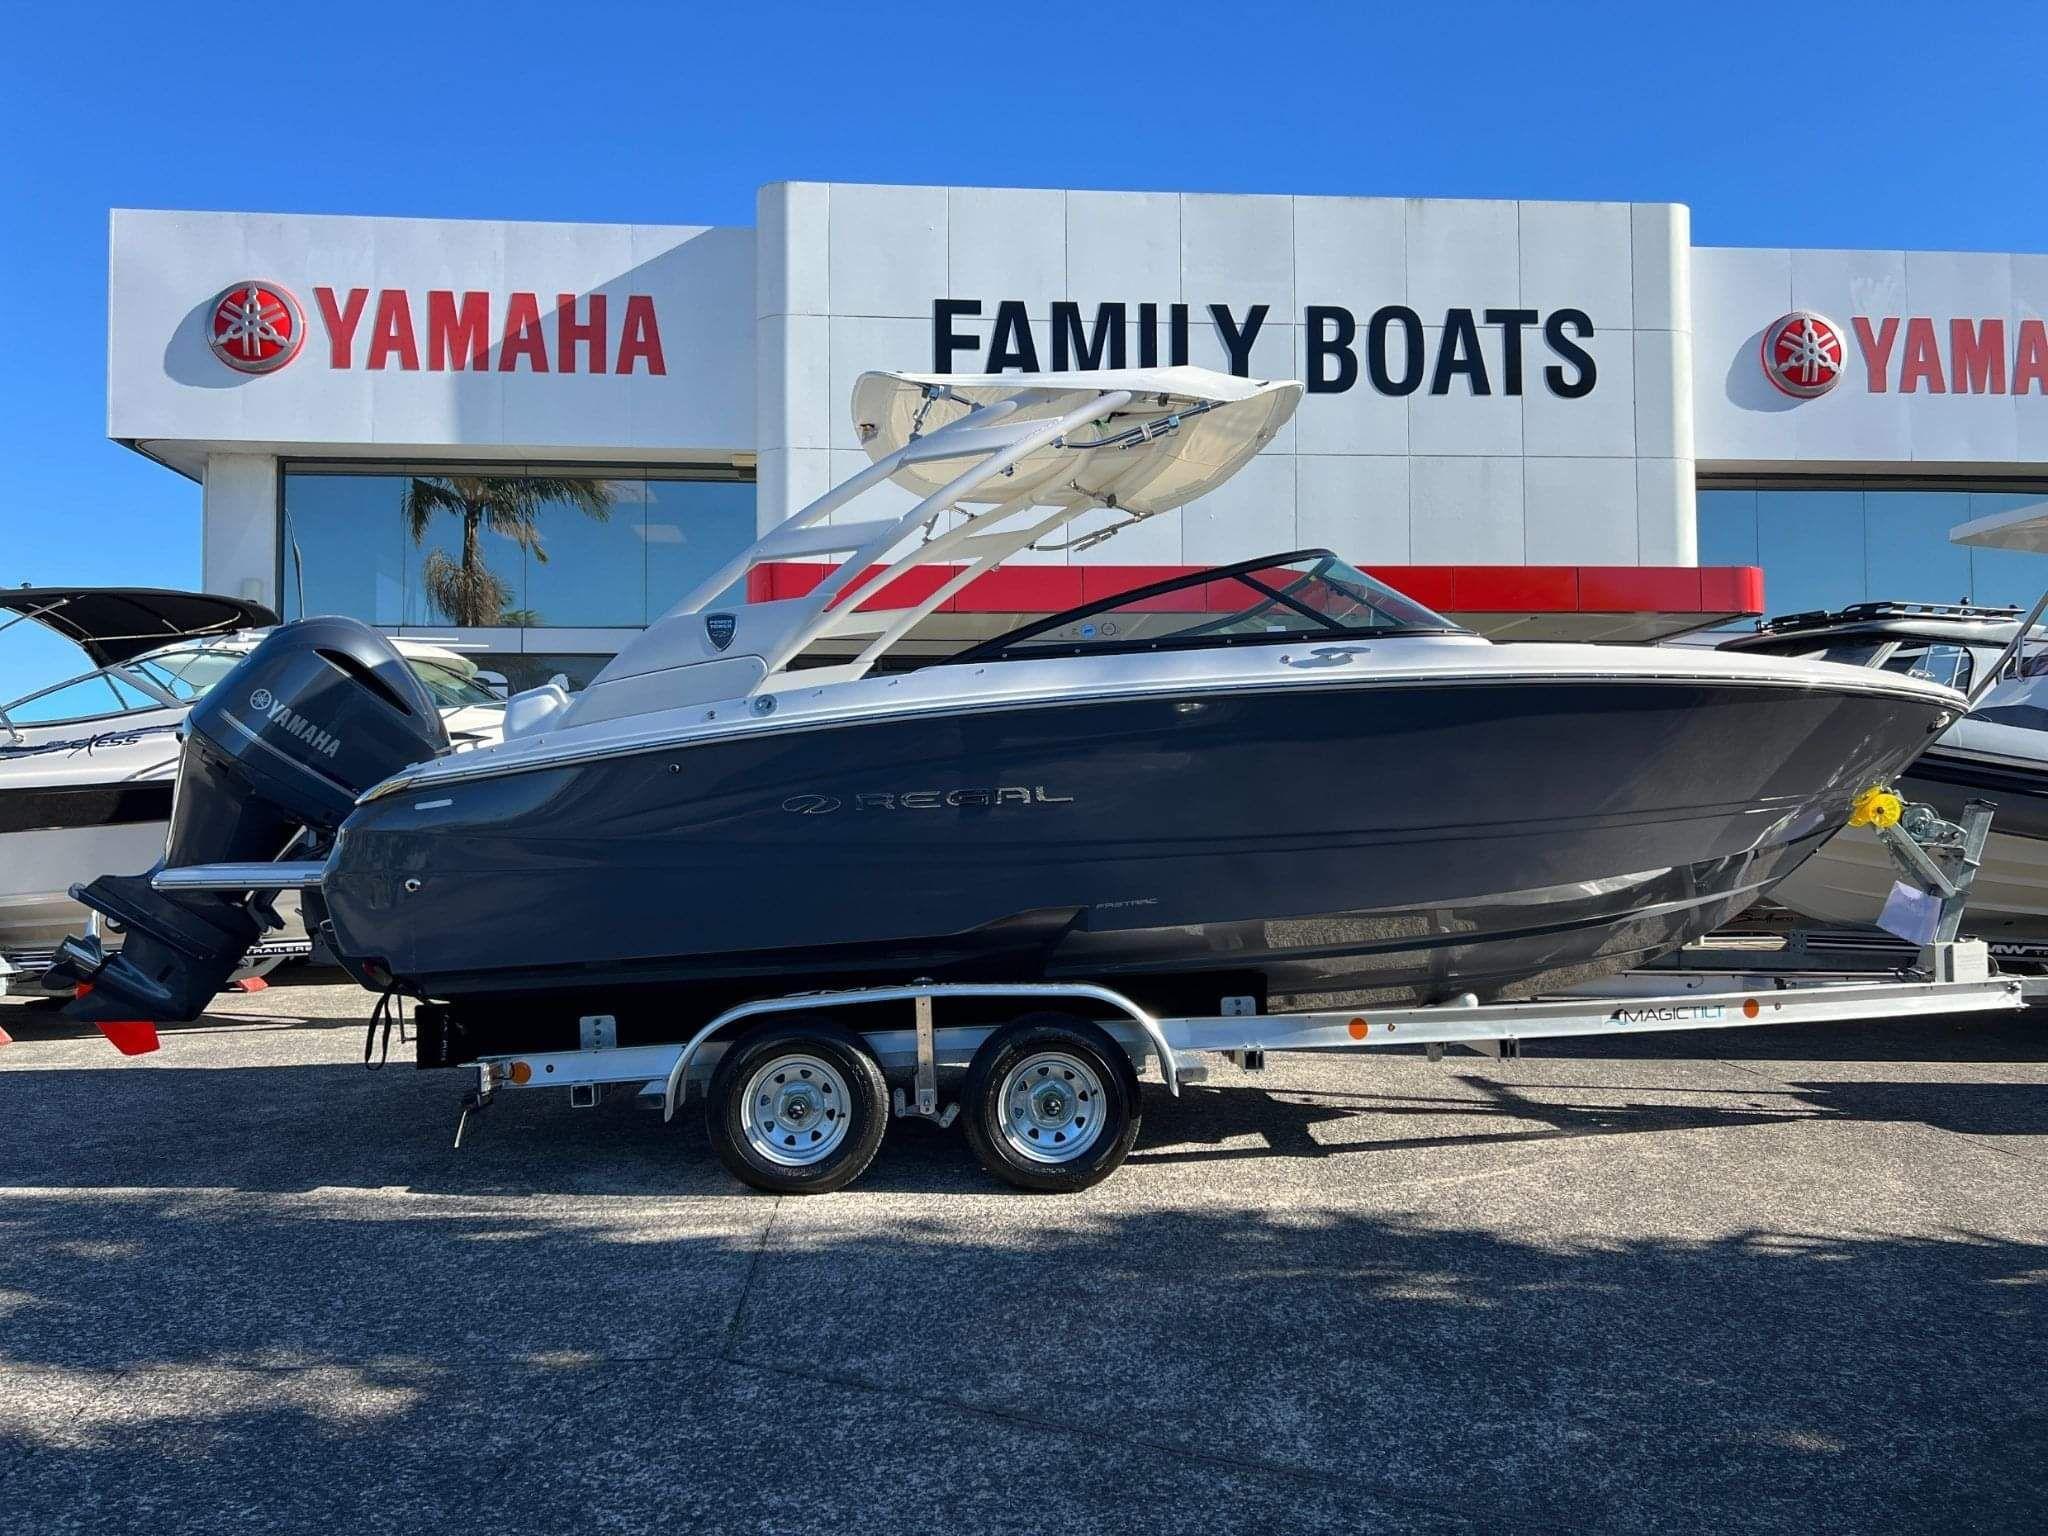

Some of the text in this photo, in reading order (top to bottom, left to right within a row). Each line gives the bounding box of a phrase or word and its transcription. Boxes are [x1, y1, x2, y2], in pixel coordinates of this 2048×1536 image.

[312, 286, 667, 376] YAMAHA
[1305, 304, 1598, 399] BOATS
[266, 699, 341, 758] YAMAHA
[855, 785, 1074, 811] REGAL
[1623, 1004, 1726, 1023] MAGICTILT
